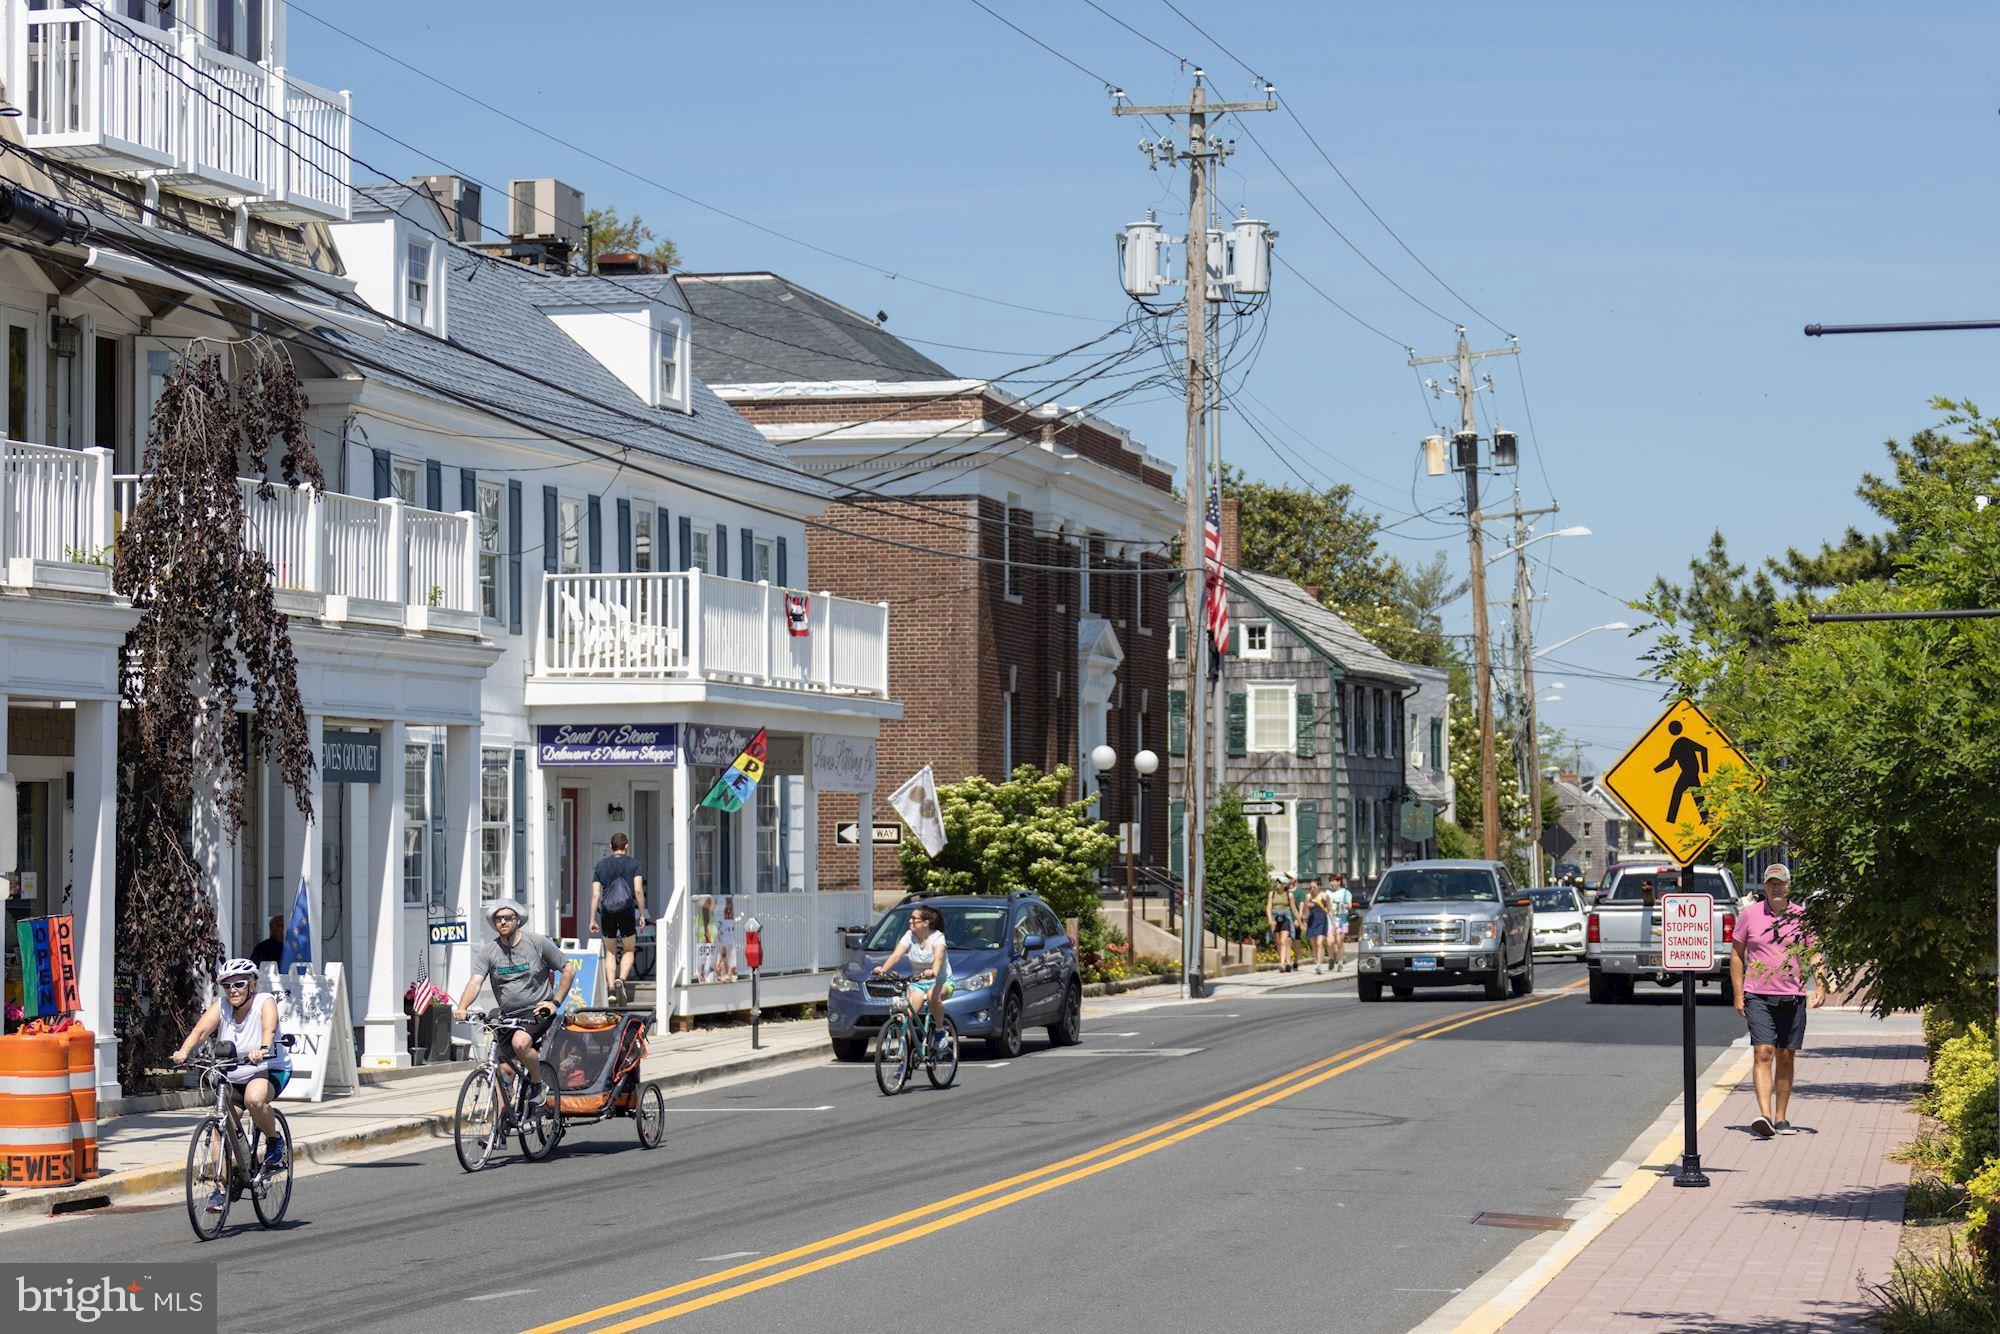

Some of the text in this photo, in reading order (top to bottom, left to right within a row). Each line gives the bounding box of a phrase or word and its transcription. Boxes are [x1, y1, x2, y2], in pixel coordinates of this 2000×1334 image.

[555, 725, 597, 744] Sand
[615, 725, 660, 744] Stones
[322, 742, 378, 771] EWES GOURMET
[542, 745, 674, 763] Delaware & Nature Shoppe
[714, 742, 764, 808] OPEN
[876, 829, 895, 838] WAY
[1678, 903, 1697, 918] NO
[431, 925, 466, 942] OPEN
[1666, 922, 1709, 932] STOPPING
[1667, 936, 1708, 946] STANDING
[1670, 950, 1706, 960] PARKING
[35, 926, 53, 1006] OPEN
